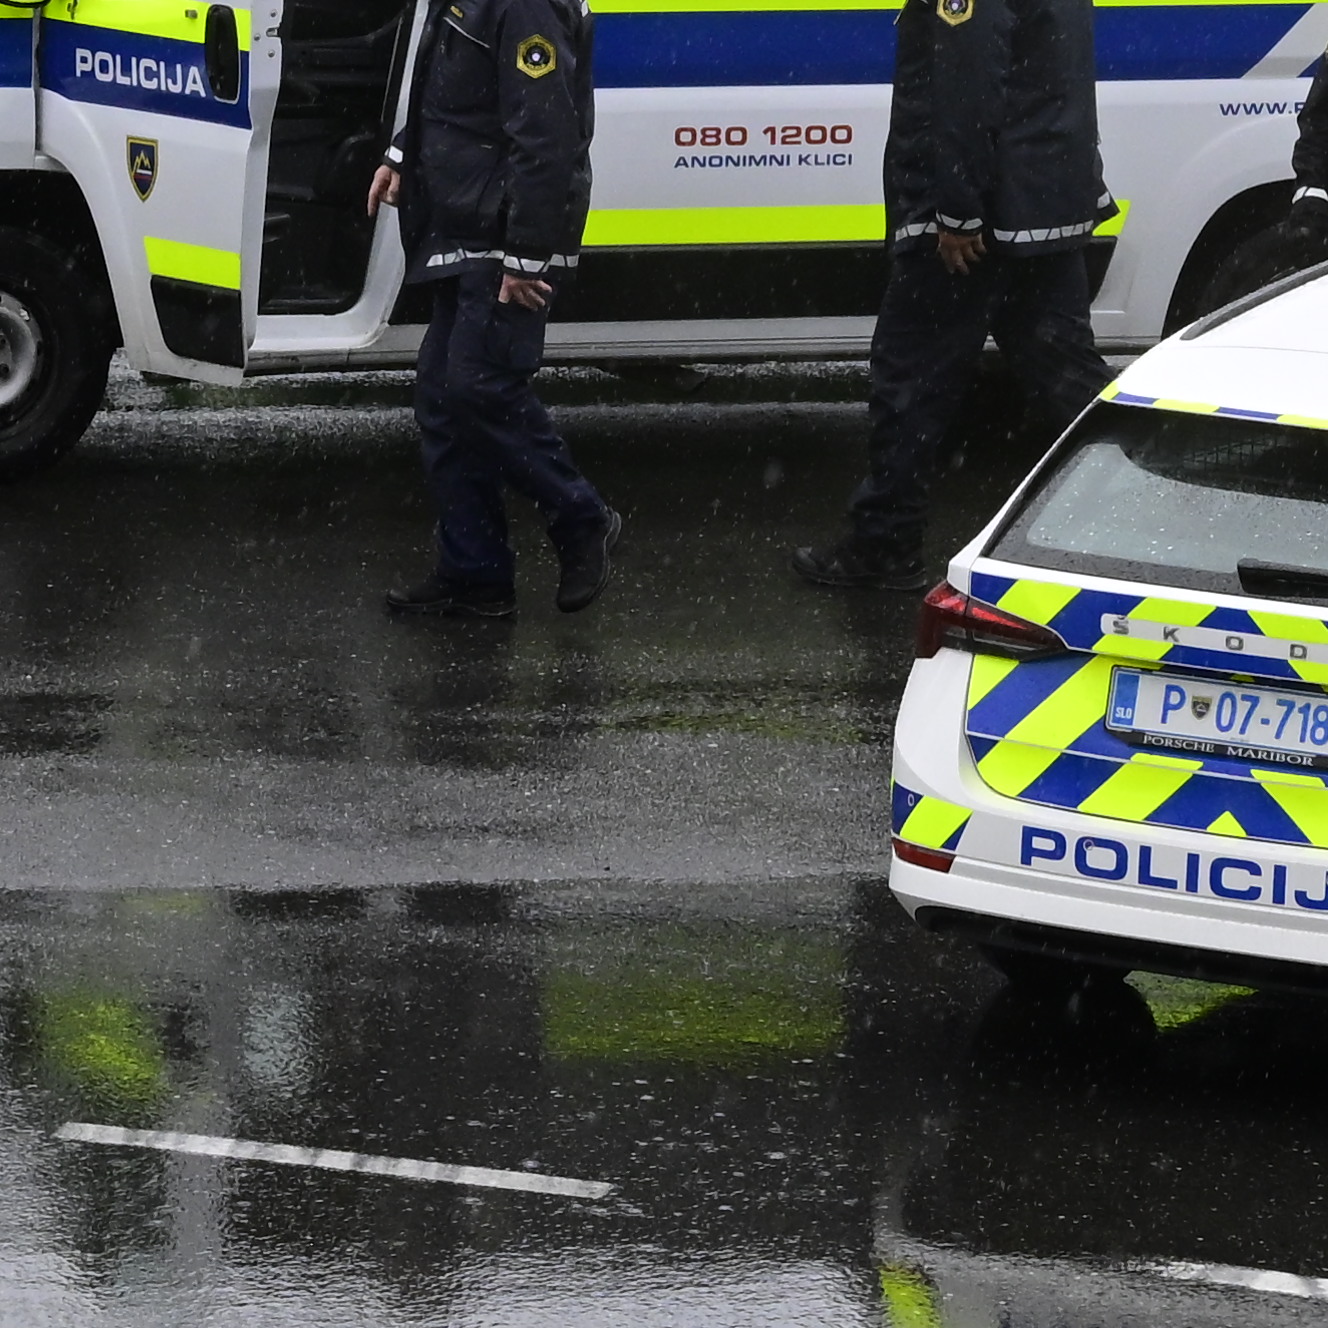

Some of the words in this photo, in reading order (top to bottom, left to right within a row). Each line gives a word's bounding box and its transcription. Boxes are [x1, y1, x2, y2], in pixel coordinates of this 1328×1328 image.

[75, 47, 207, 98] POLICIJA
[674, 127, 748, 146] 080
[762, 125, 853, 145] 1200
[674, 155, 791, 168] ANONIMNI
[798, 153, 853, 166] KLICI
[1115, 706, 1133, 720] SLO
[1160, 684, 1186, 725] P
[1143, 734, 1216, 753] PORSCHE
[1226, 746, 1314, 767] MARIBOR
